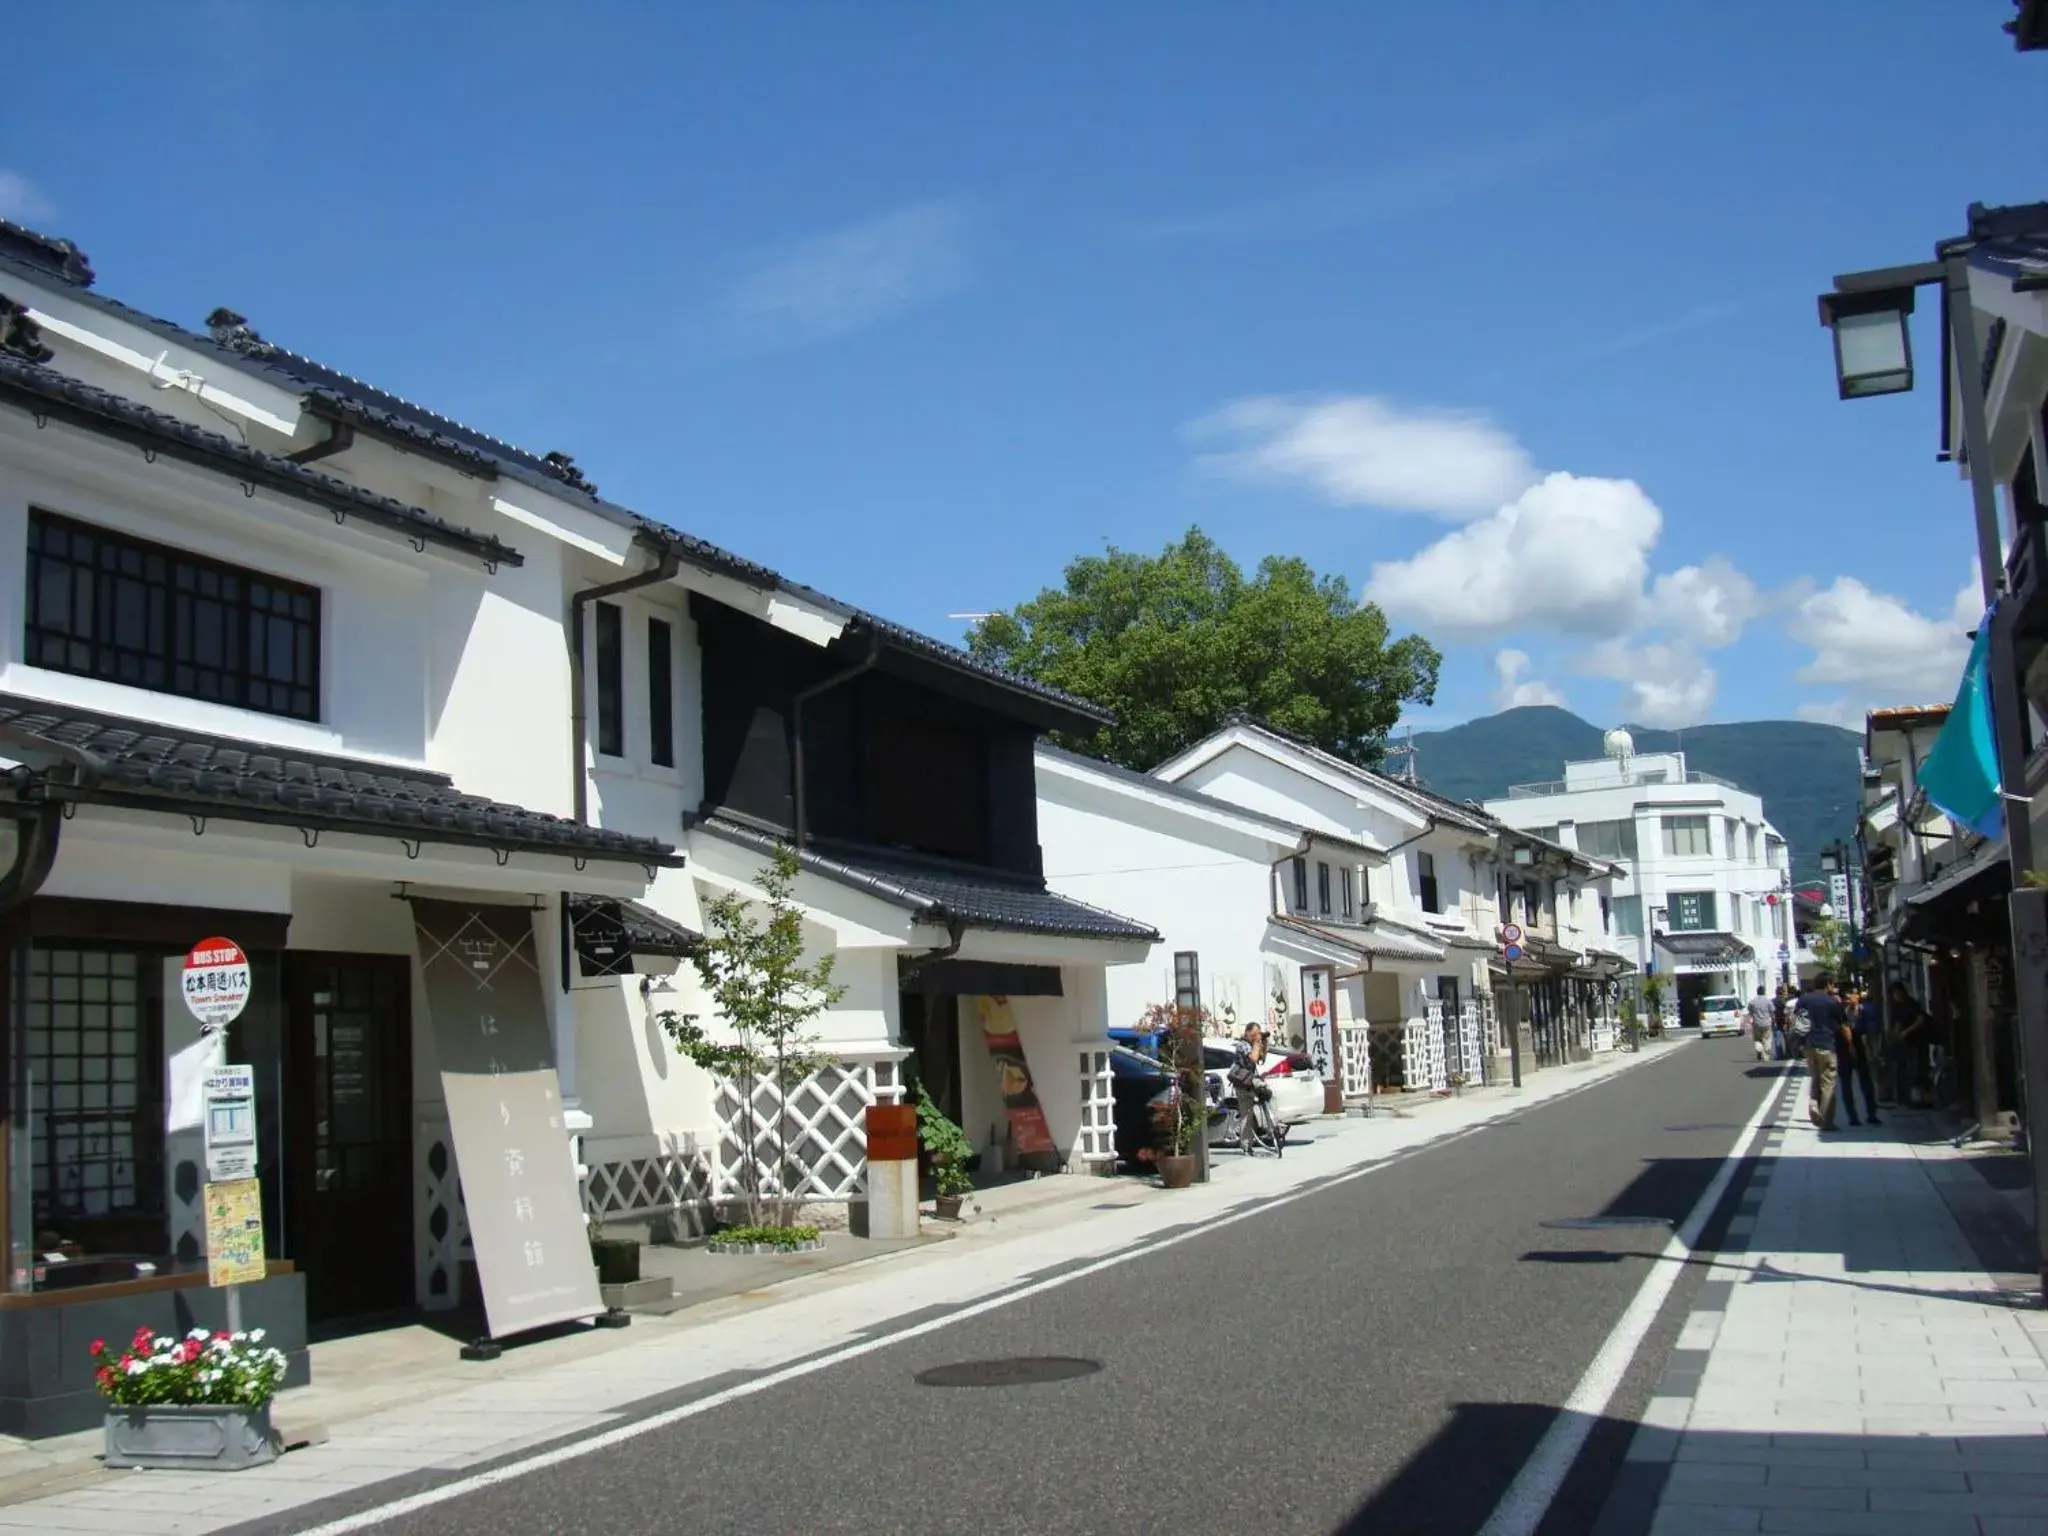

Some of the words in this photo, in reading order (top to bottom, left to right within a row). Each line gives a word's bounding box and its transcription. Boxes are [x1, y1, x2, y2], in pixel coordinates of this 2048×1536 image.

[193, 950, 213, 964] BUS
[214, 948, 238, 963] STOP
[186, 971, 248, 993] 松本周遊バス
[1311, 1019, 1328, 1076] 竹風堂
[479, 1014, 545, 1267] はかり資料館
